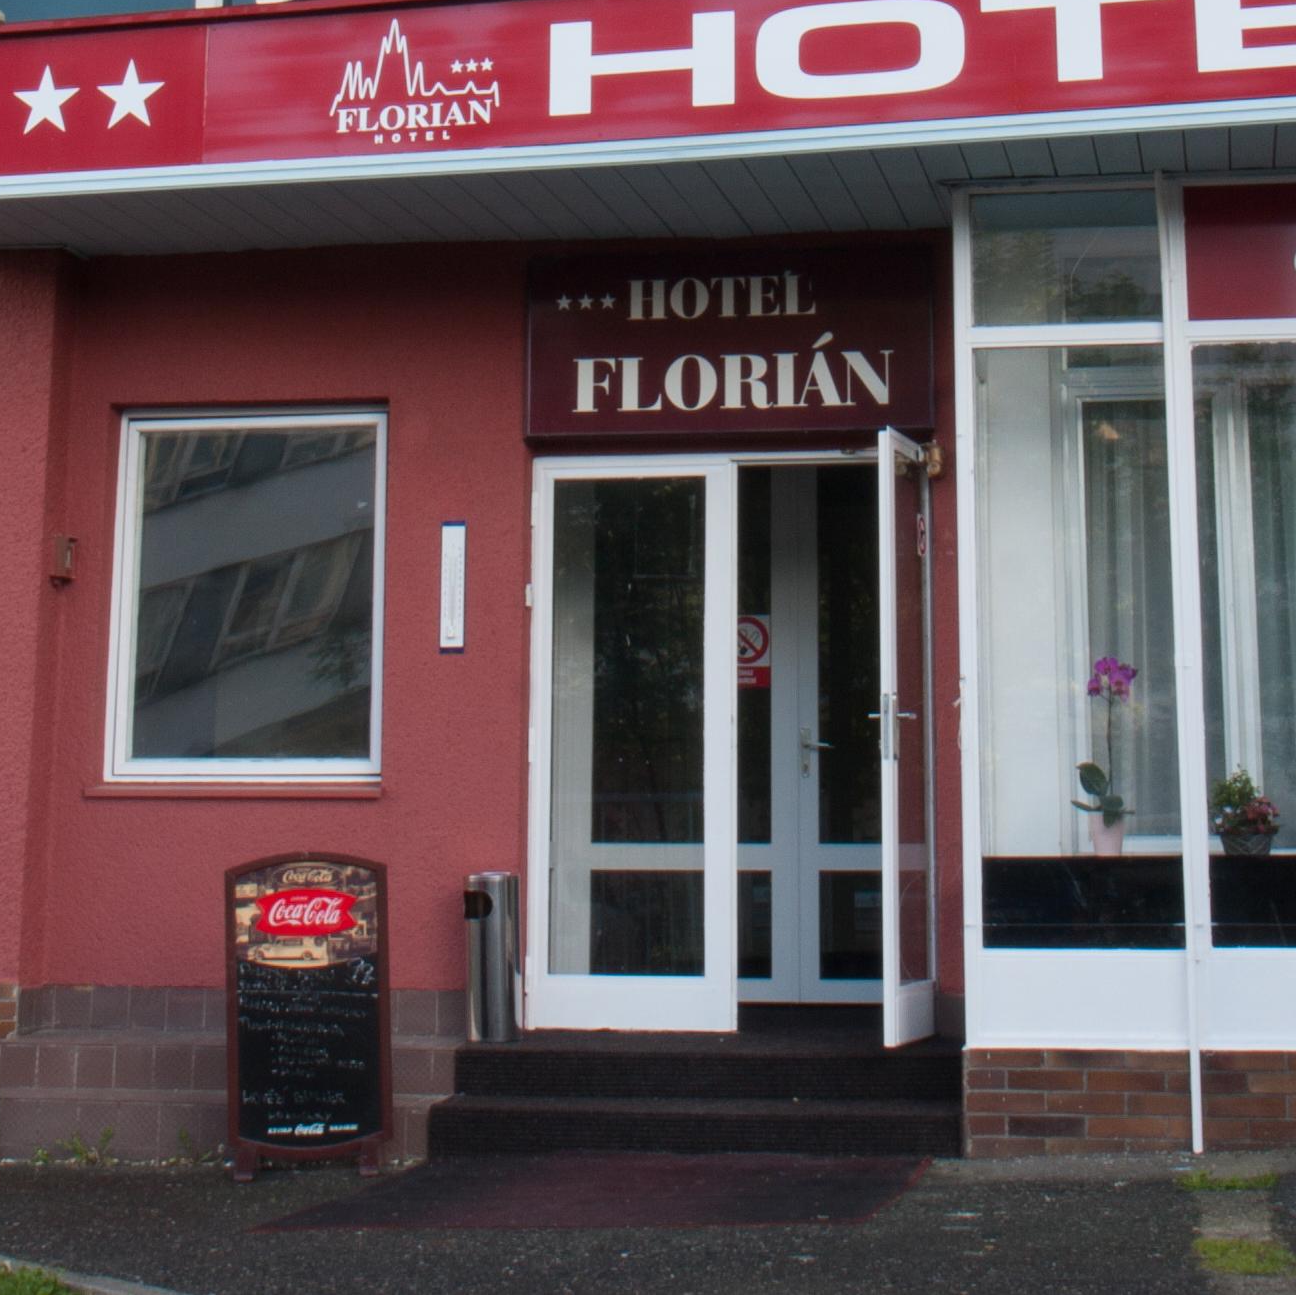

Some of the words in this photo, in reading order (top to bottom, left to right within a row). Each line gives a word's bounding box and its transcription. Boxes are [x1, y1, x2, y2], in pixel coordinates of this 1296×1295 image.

[335, 99, 494, 134] FLORIAN
[374, 130, 451, 145] HOTEL
[626, 273, 817, 321] HOTEL
[572, 331, 894, 414] FLORIÁN
[268, 896, 344, 927] Coca-Cola
